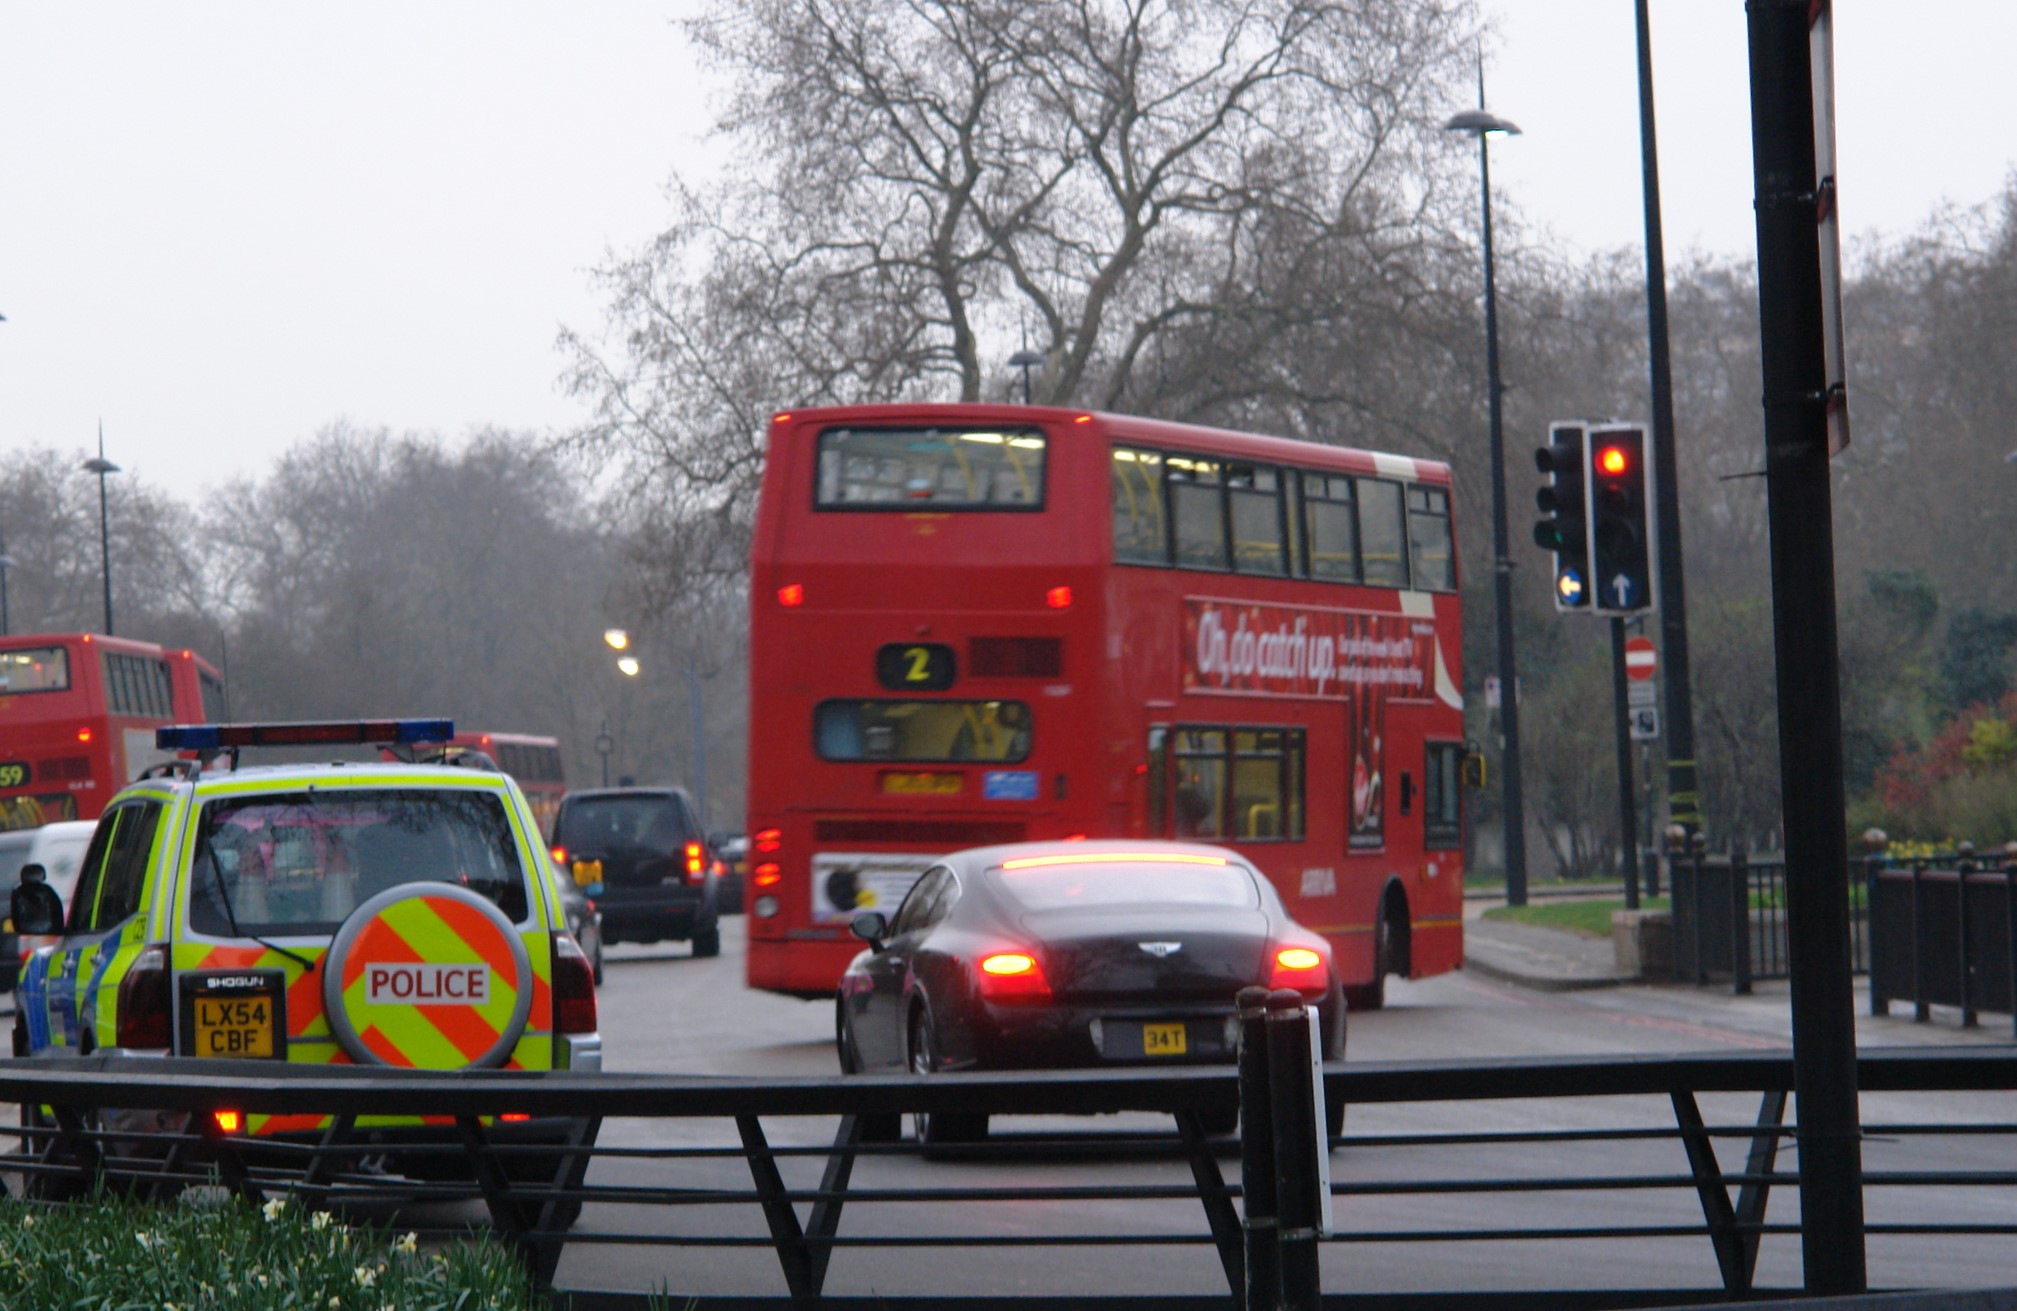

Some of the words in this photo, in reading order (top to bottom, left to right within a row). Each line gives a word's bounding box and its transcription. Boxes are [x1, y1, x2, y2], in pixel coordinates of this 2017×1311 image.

[1197, 609, 1229, 685] Oh,
[1231, 612, 1256, 675] do
[1257, 615, 1306, 678] catch
[903, 647, 931, 681] 2
[207, 976, 264, 988] SHOGUN
[371, 969, 484, 998] POLICE
[202, 1003, 266, 1026] LX54
[210, 1029, 257, 1052] CBF
